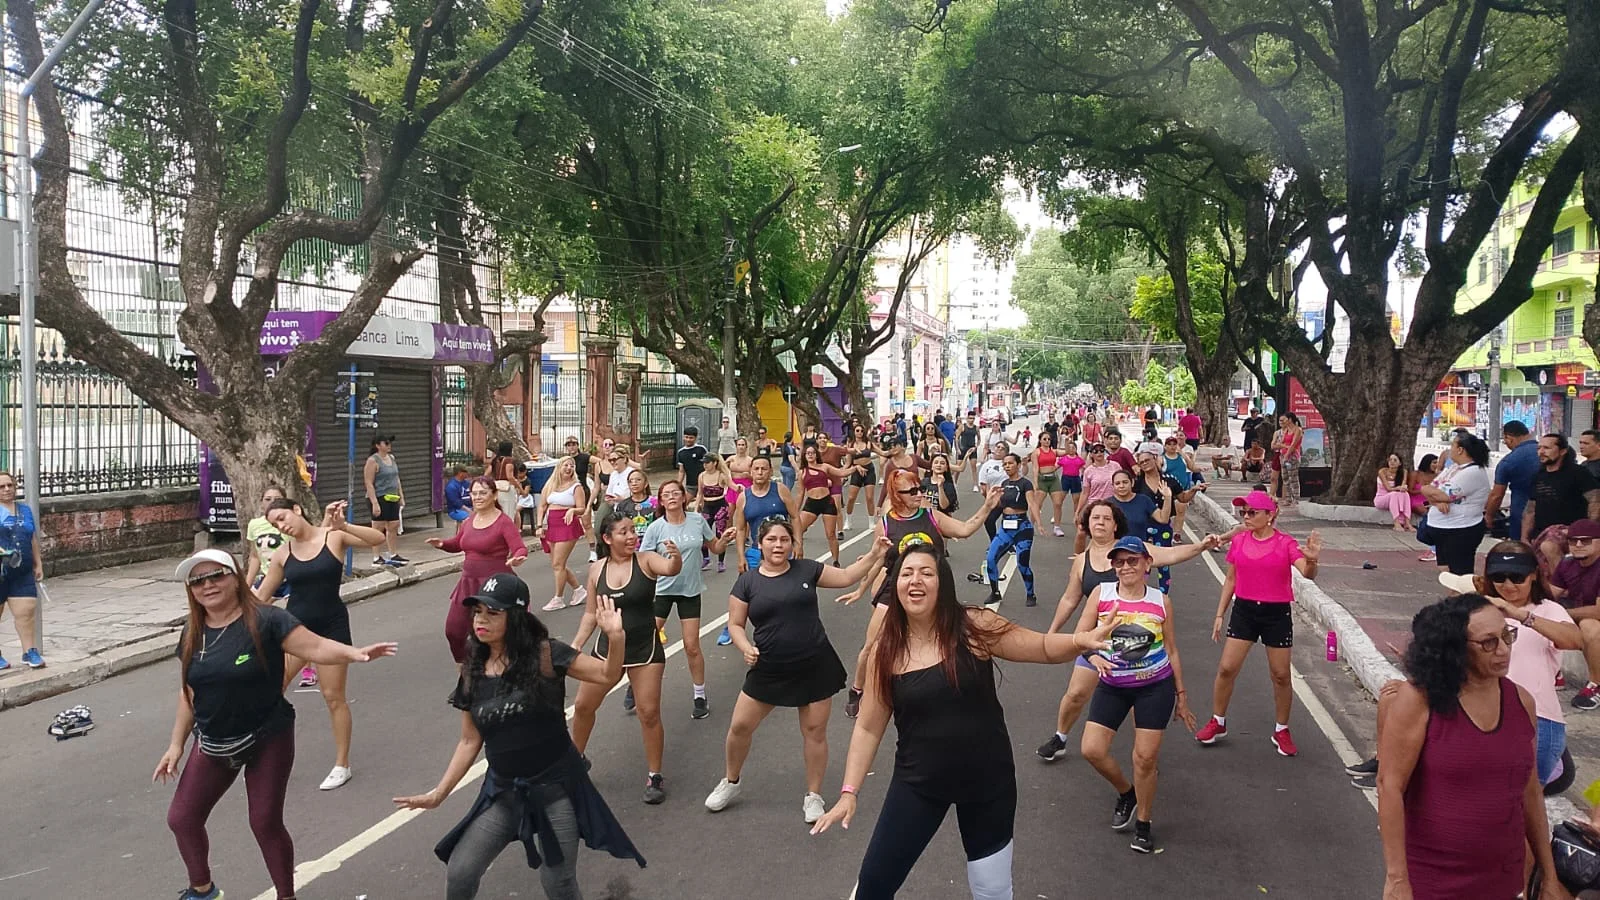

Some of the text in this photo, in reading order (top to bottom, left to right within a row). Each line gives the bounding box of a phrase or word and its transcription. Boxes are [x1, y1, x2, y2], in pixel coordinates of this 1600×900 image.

[262, 318, 299, 330] qui tem
[260, 332, 289, 345] vivo
[395, 330, 419, 346] Lima
[442, 336, 487, 351] Aqui tem vivo
